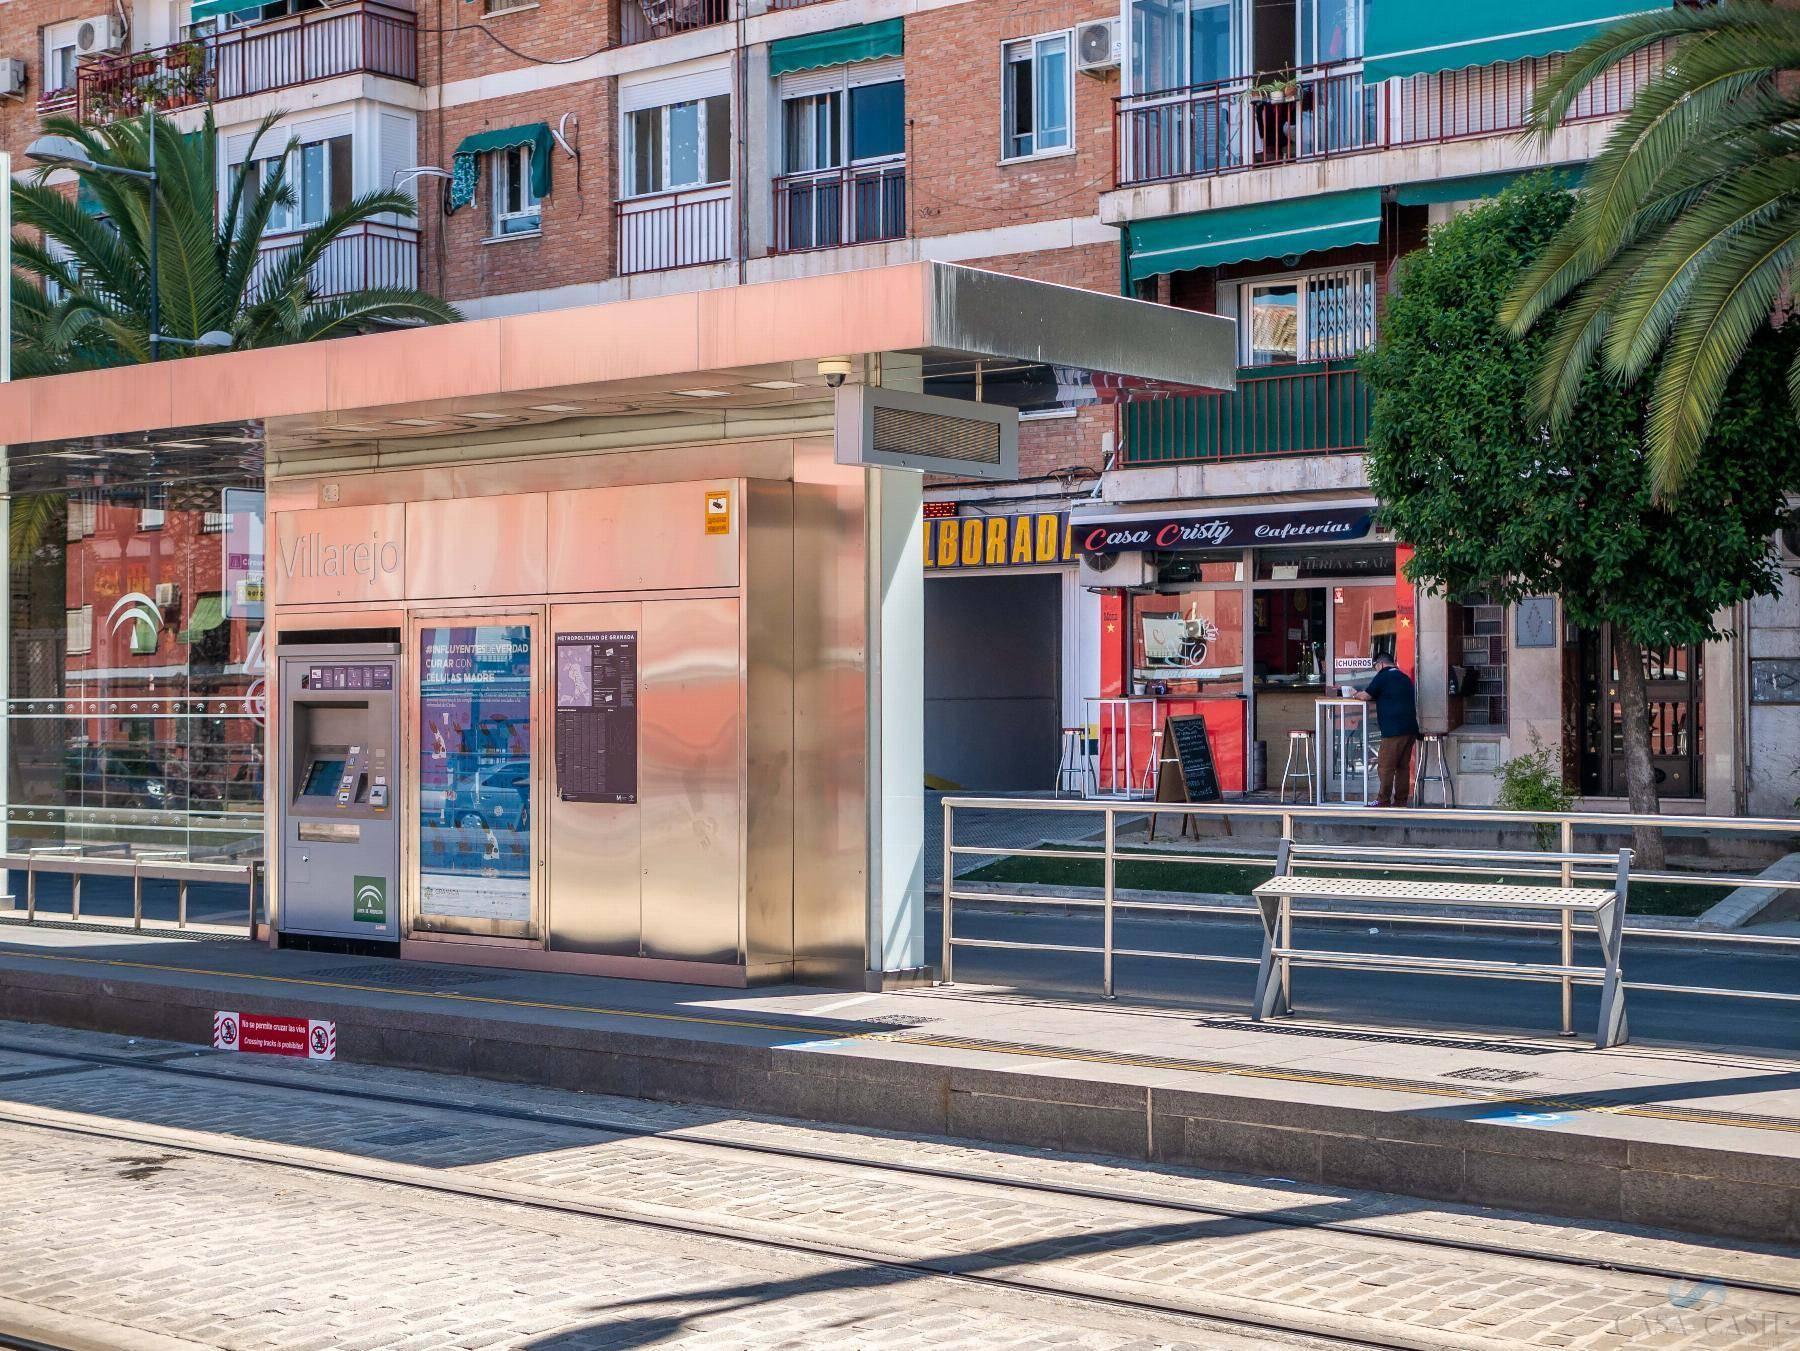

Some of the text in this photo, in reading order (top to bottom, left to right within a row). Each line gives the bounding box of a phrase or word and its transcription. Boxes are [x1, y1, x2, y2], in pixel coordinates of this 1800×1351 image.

[1085, 520, 1233, 550] Casa Cristy
[1254, 521, 1352, 539] Cafeterías
[279, 530, 399, 585] Villarejo
[425, 658, 472, 668] CURAR CON
[463, 673, 496, 683] MADRE
[241, 1020, 249, 1028] No
[255, 1021, 273, 1031] permite
[273, 1023, 288, 1032] cruzar
[288, 1024, 296, 1033] las
[244, 1036, 304, 1050] Crossing tracks is prohibited
